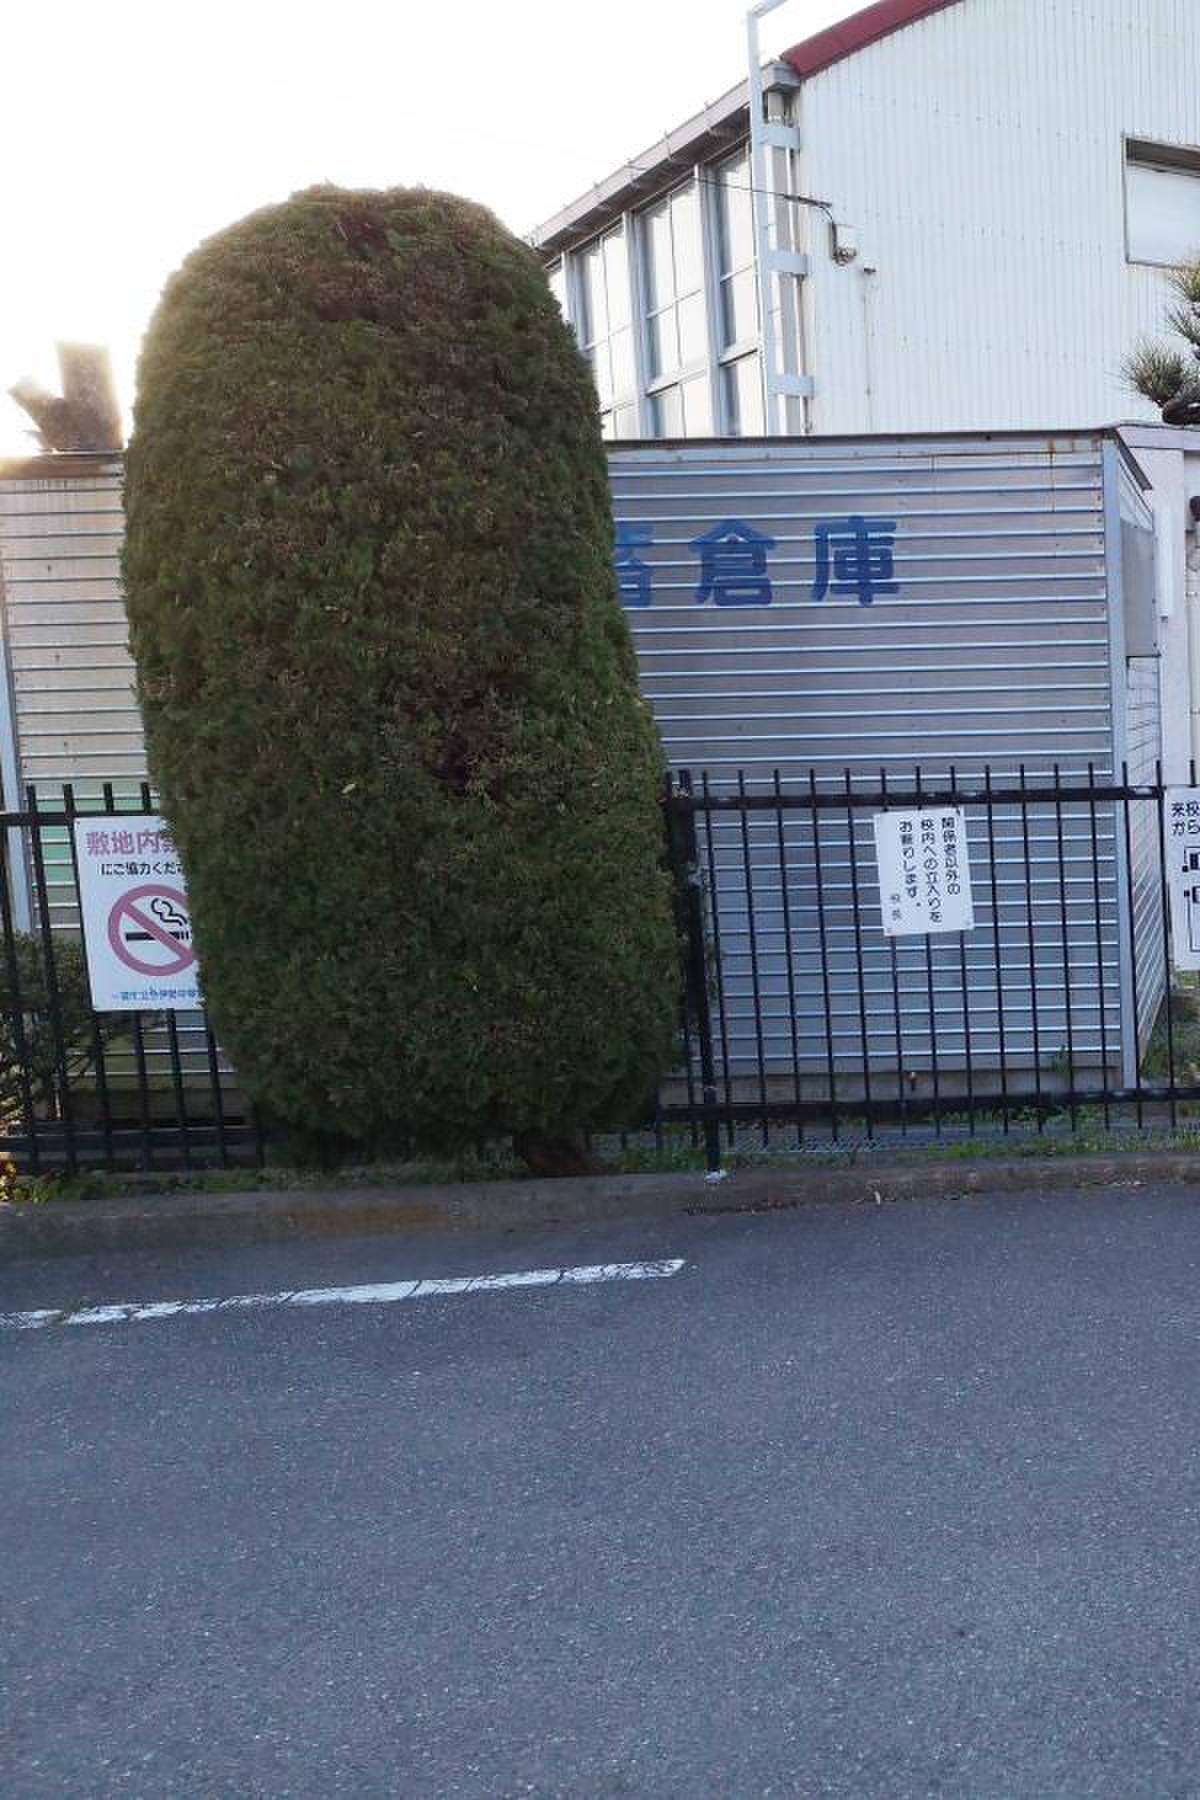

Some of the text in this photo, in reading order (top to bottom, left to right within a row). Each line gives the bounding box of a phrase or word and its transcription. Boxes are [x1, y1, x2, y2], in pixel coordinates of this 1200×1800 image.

[941, 817, 961, 895] 関係者以外の
